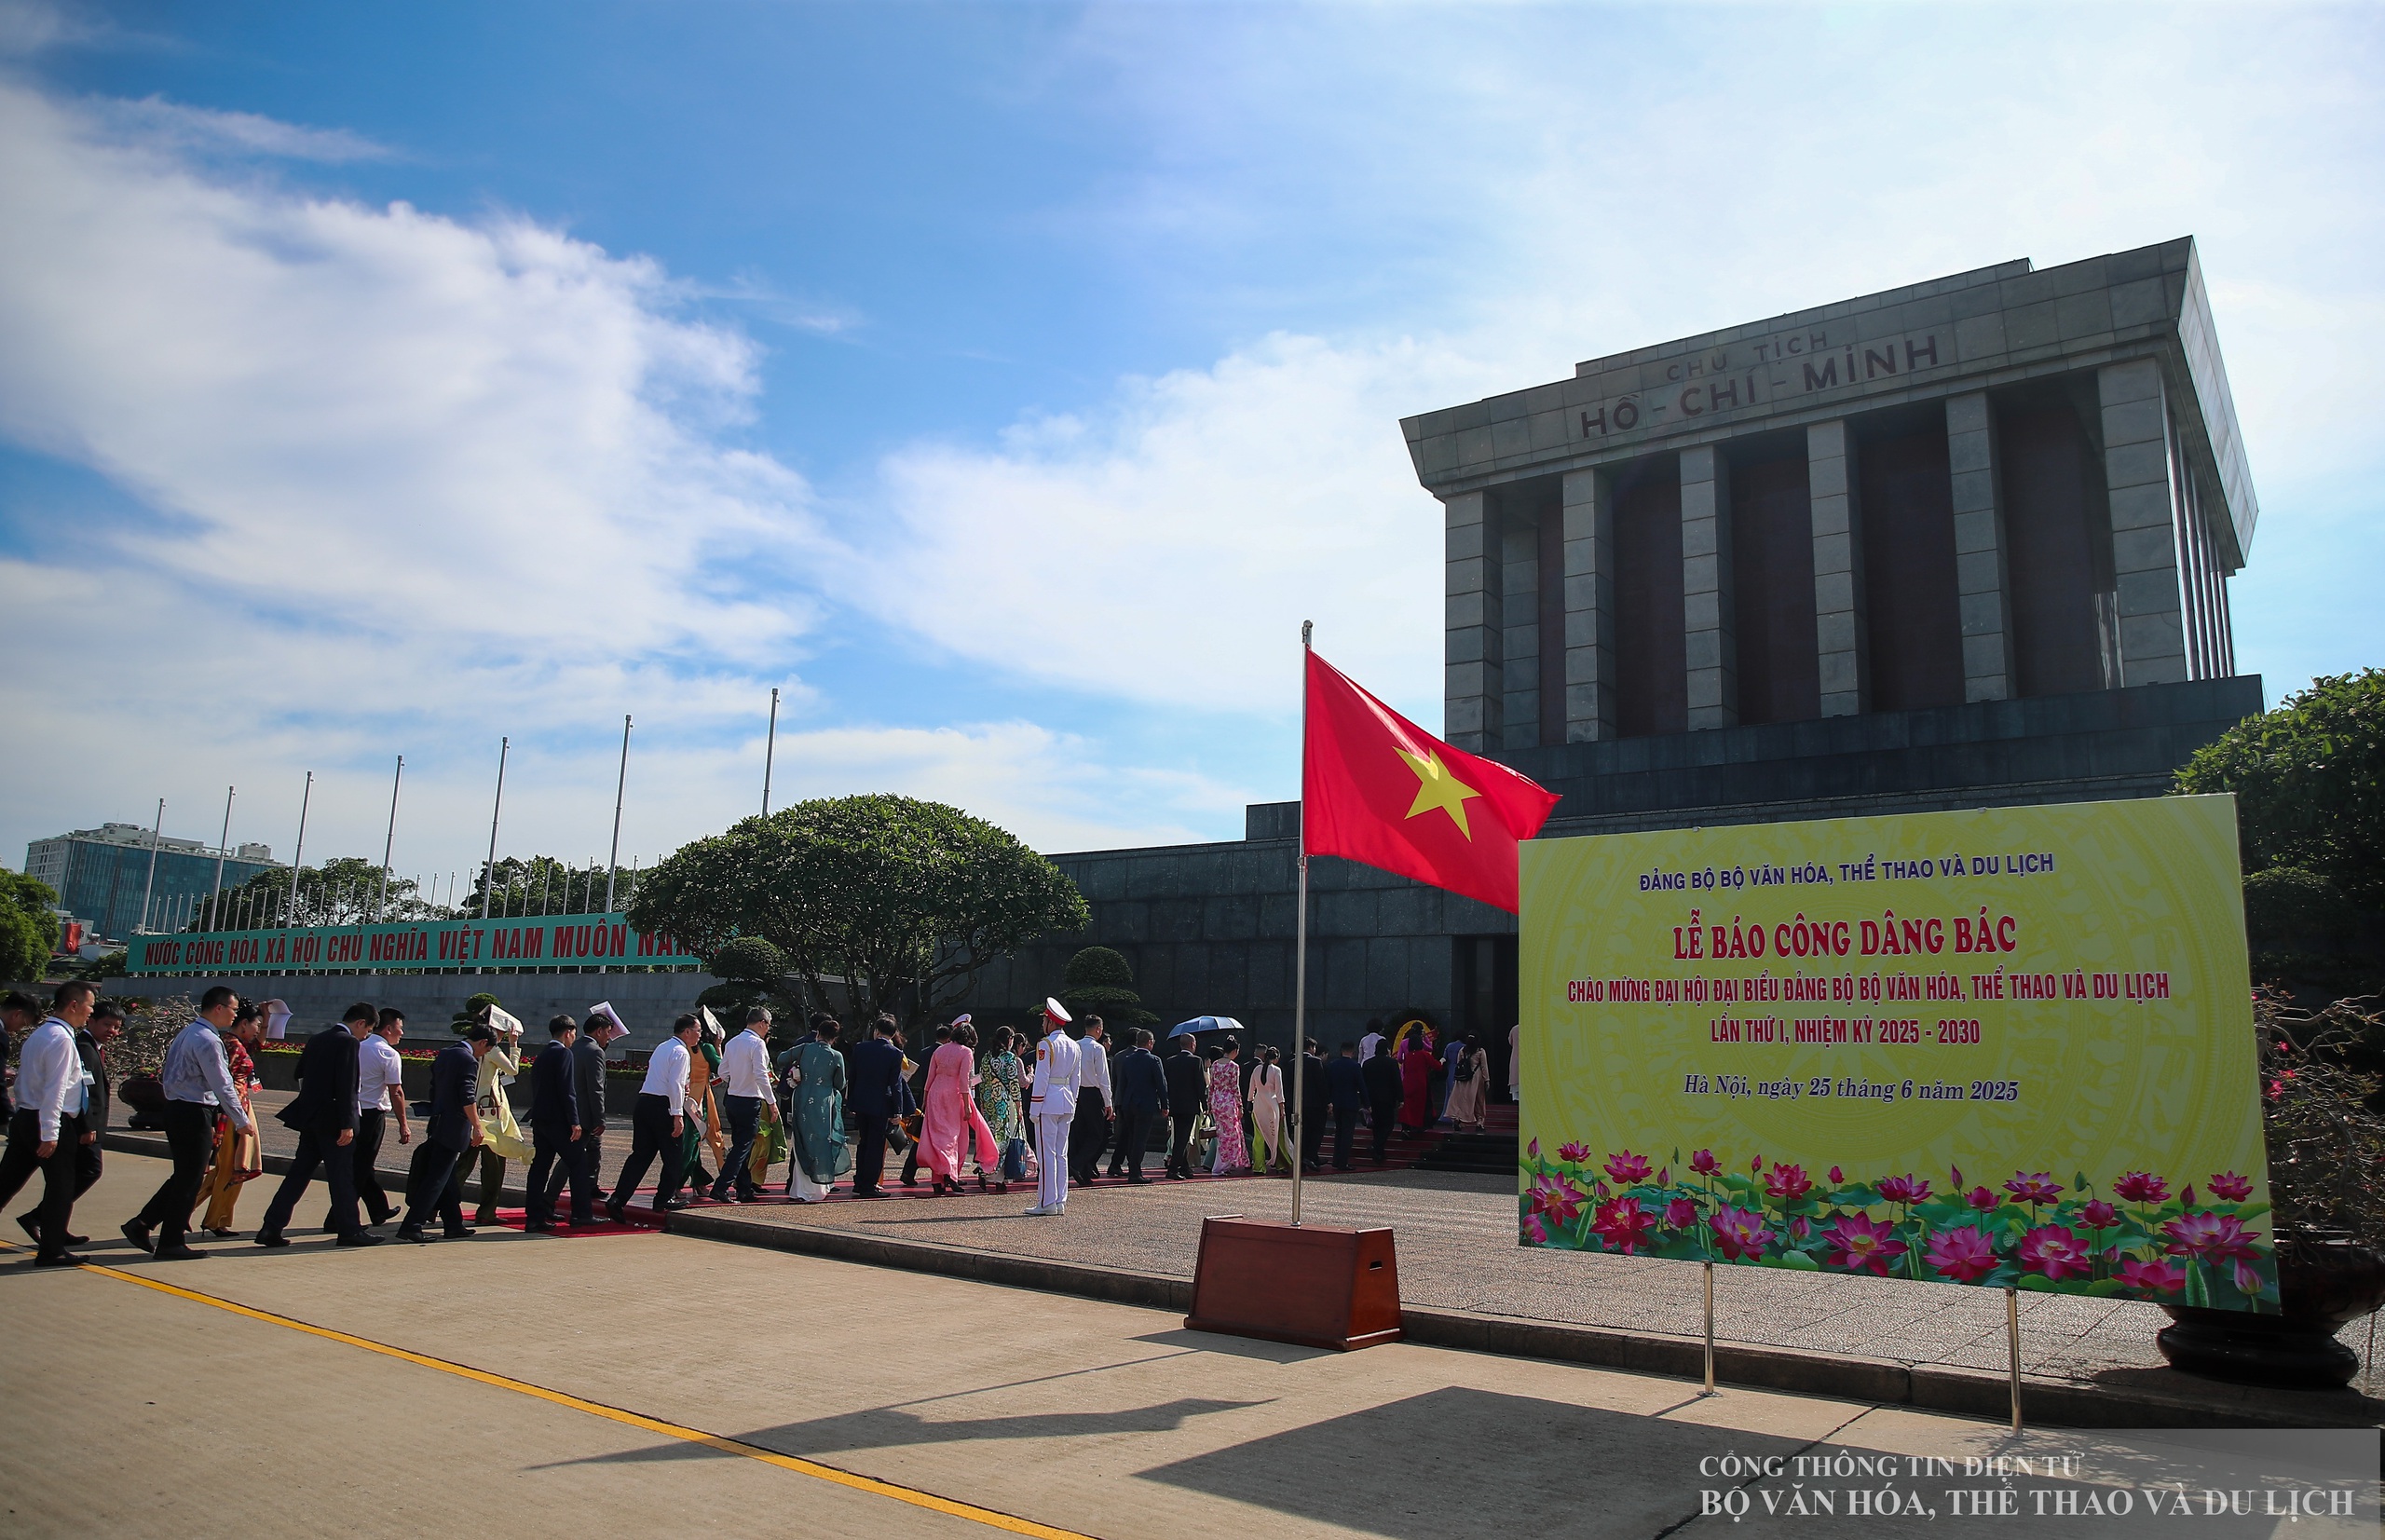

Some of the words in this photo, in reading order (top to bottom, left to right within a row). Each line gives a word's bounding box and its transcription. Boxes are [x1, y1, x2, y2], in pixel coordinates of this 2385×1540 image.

[1680, 366, 1757, 416] CHÍ
[1639, 866, 1685, 892] ĐẢNG
[1691, 866, 1715, 892] BỘ
[1720, 865, 1745, 890] BỘ
[1750, 864, 1784, 885] VĂN
[1791, 862, 1833, 885] HÓA,
[1839, 853, 1875, 881] THỂ
[1881, 859, 1934, 879] THAO
[1939, 852, 1966, 877] VÀ
[1971, 855, 2000, 876] DU
[2006, 852, 2053, 878] LỊCH
[144, 937, 181, 966] NƯỚC
[184, 936, 224, 969] CỘNG
[229, 935, 258, 964] HÒA
[265, 934, 285, 962] XÃ
[292, 932, 321, 967] HỘI
[327, 926, 362, 962] CHỦ
[369, 926, 428, 961] NGHĨA
[439, 923, 484, 965] VIỆT
[491, 927, 544, 960] NAM
[552, 919, 628, 957] MUÔN
[1673, 908, 1704, 960] LỄ
[1710, 915, 1765, 959] BÁO
[1774, 912, 1851, 958] CÔNG
[1860, 908, 1944, 956] DÂNG
[1953, 906, 2016, 954] BÁC
[1567, 975, 1603, 1002] CHÀO
[1608, 975, 1651, 1002] MỪNG
[1655, 978, 1679, 1006] ĐẠI
[1683, 974, 1709, 1006] HỘI
[1713, 978, 1738, 1006] ĐẠI
[1743, 969, 1779, 1002] BIỂU
[1783, 970, 1827, 1002] ĐẢNG
[1832, 972, 1853, 1006] BỘ
[1859, 972, 1881, 1005] BỘ
[1886, 971, 1920, 1001] VĂN
[1926, 970, 1966, 1002] HÓA,
[1971, 965, 2004, 1000] THỂ
[2009, 973, 2056, 1000] THAO
[2061, 969, 2087, 999] VÀ
[2092, 973, 2119, 999] DU
[2124, 972, 2170, 1004] LỊCH
[1710, 1012, 1740, 1043] LẦN
[1745, 1015, 1775, 1043] THỨ
[1779, 1018, 1790, 1046] I,
[1794, 1014, 1847, 1048] NHIỆM
[1852, 1015, 1873, 1043] KỲ
[1878, 1019, 1919, 1044] 2025
[1937, 1019, 1981, 1044] 2030
[1683, 1074, 1709, 1095] Hà
[1714, 1075, 1751, 1099] Nội,
[1756, 1078, 1804, 1100] ngày
[1808, 1077, 1832, 1097] 25
[1835, 1077, 1896, 1102] tháng
[1901, 1080, 1914, 1099] 6
[1917, 1081, 1965, 1100] năm
[1969, 1081, 2020, 1101] 2025
